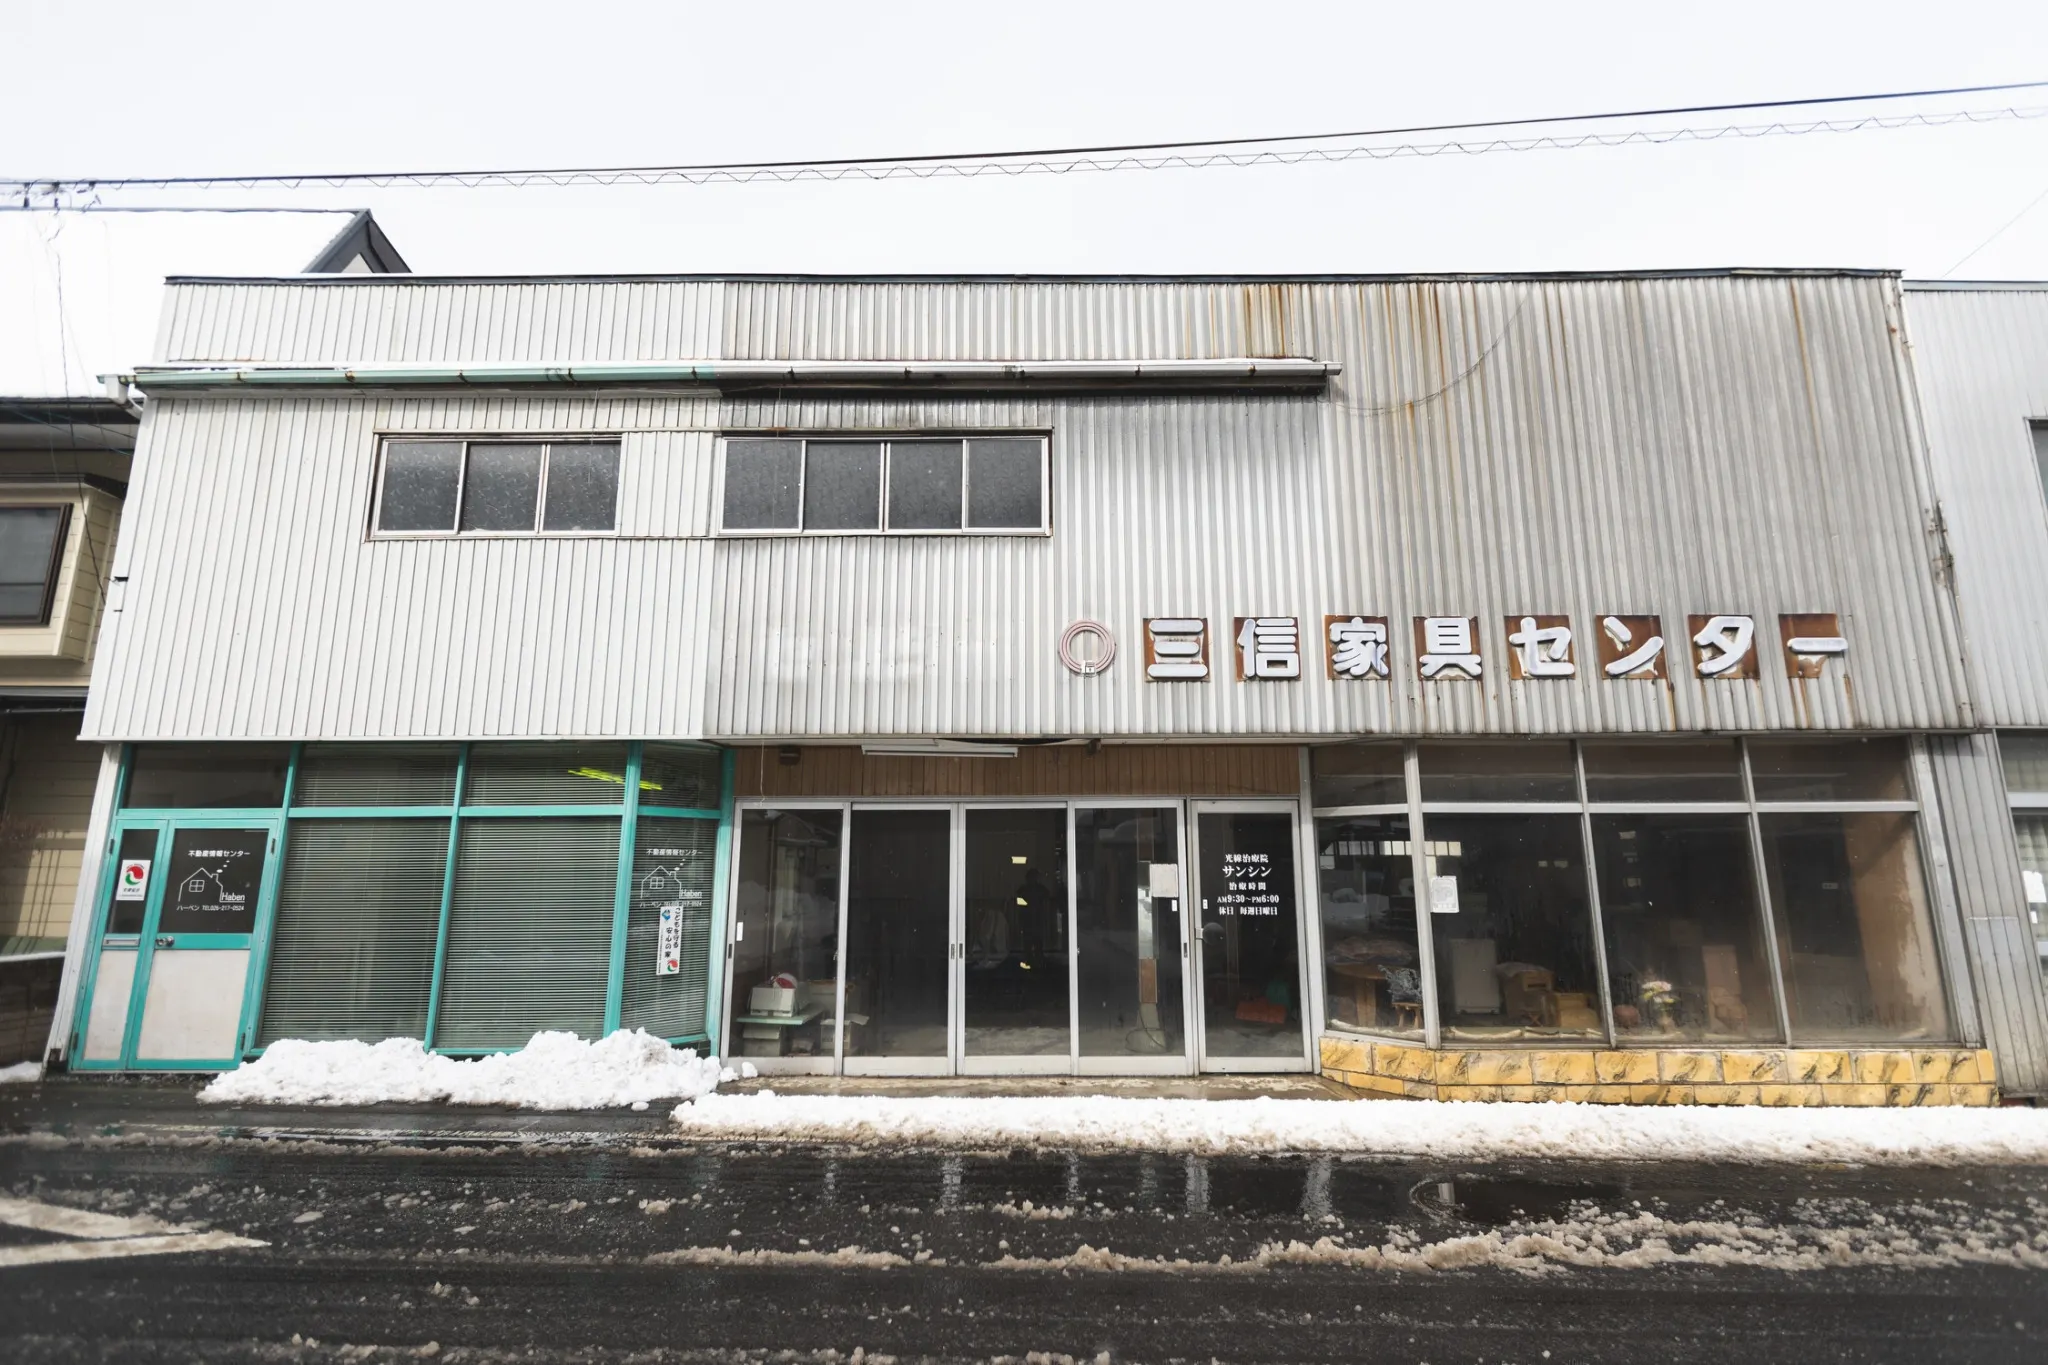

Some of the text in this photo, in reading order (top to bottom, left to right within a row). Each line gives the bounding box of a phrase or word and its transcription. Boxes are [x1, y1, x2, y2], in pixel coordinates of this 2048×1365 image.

[1147, 616, 1849, 679] 三信家具センター
[188, 850, 251, 858] 不動産情報センター
[1225, 854, 1269, 863] 光線治療院
[1222, 865, 1272, 878] サンシン
[1228, 882, 1267, 891] 治療時間
[221, 892, 246, 901] Haben
[1219, 906, 1278, 915] 休日 毎週日曜日
[664, 926, 673, 958] 安心の家
